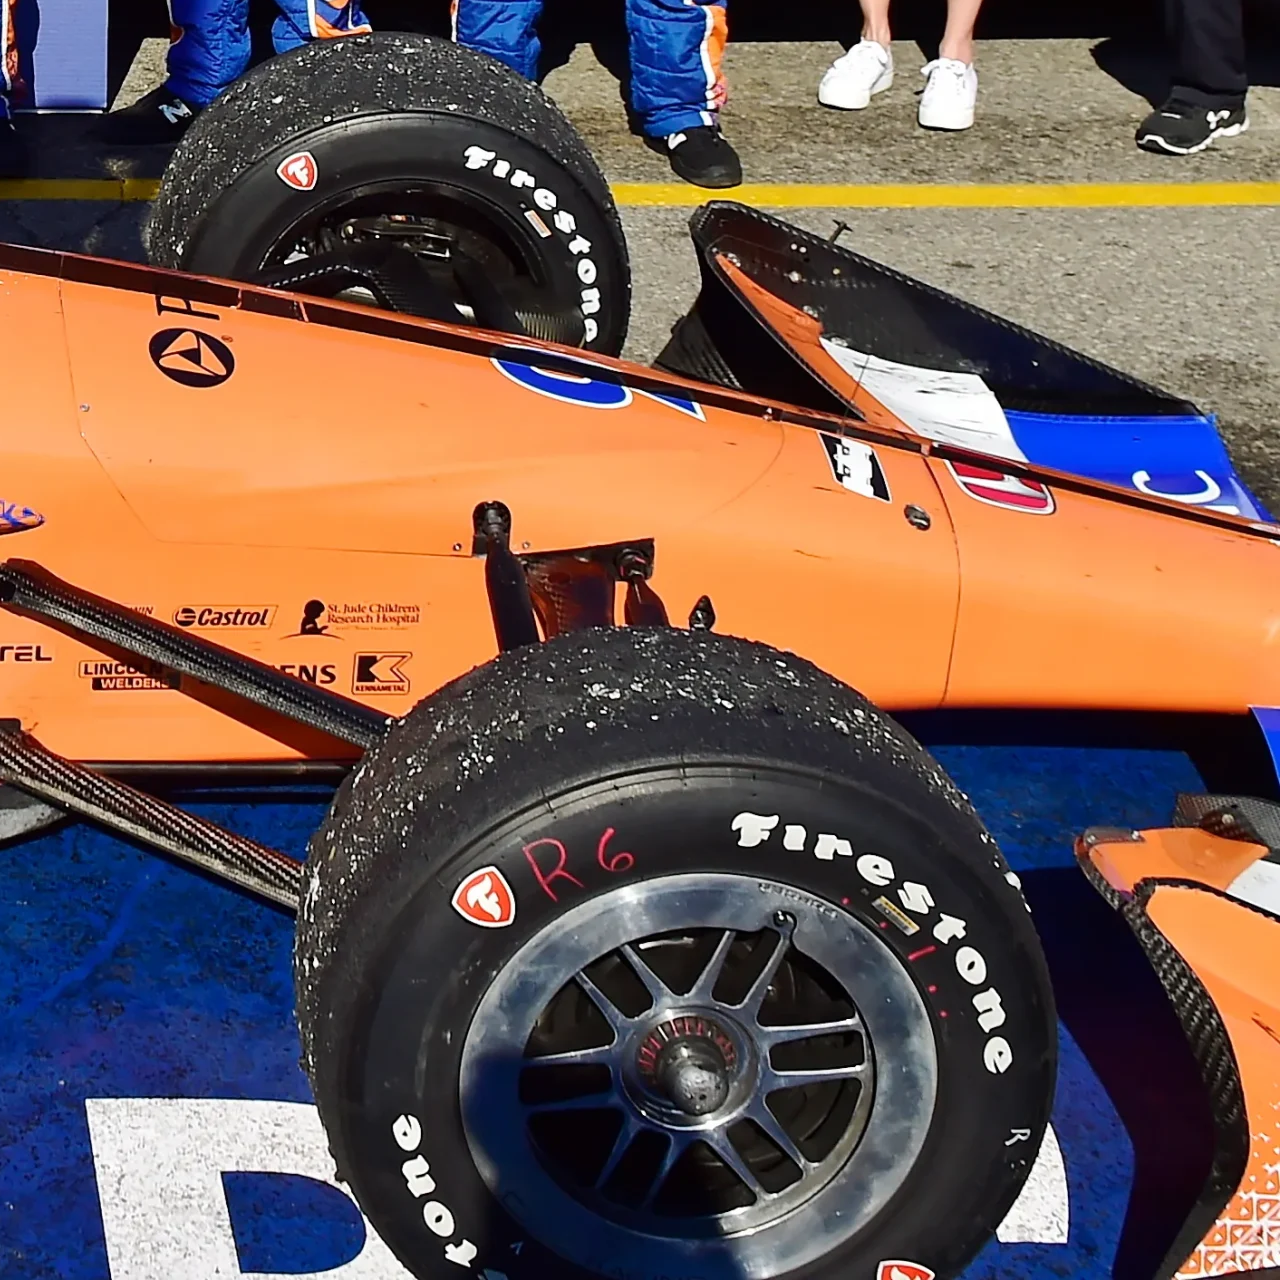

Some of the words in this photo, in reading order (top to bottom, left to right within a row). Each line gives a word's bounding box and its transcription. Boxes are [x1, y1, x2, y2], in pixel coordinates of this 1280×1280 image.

[463, 145, 602, 343] Firestone
[196, 607, 269, 627] Castrol
[327, 604, 341, 614] St.
[344, 603, 367, 615] Jude
[327, 613, 374, 624] Research
[376, 613, 420, 626] Hospital
[521, 835, 585, 904] R
[597, 826, 635, 873] 6
[730, 811, 1013, 1076] Firestone
